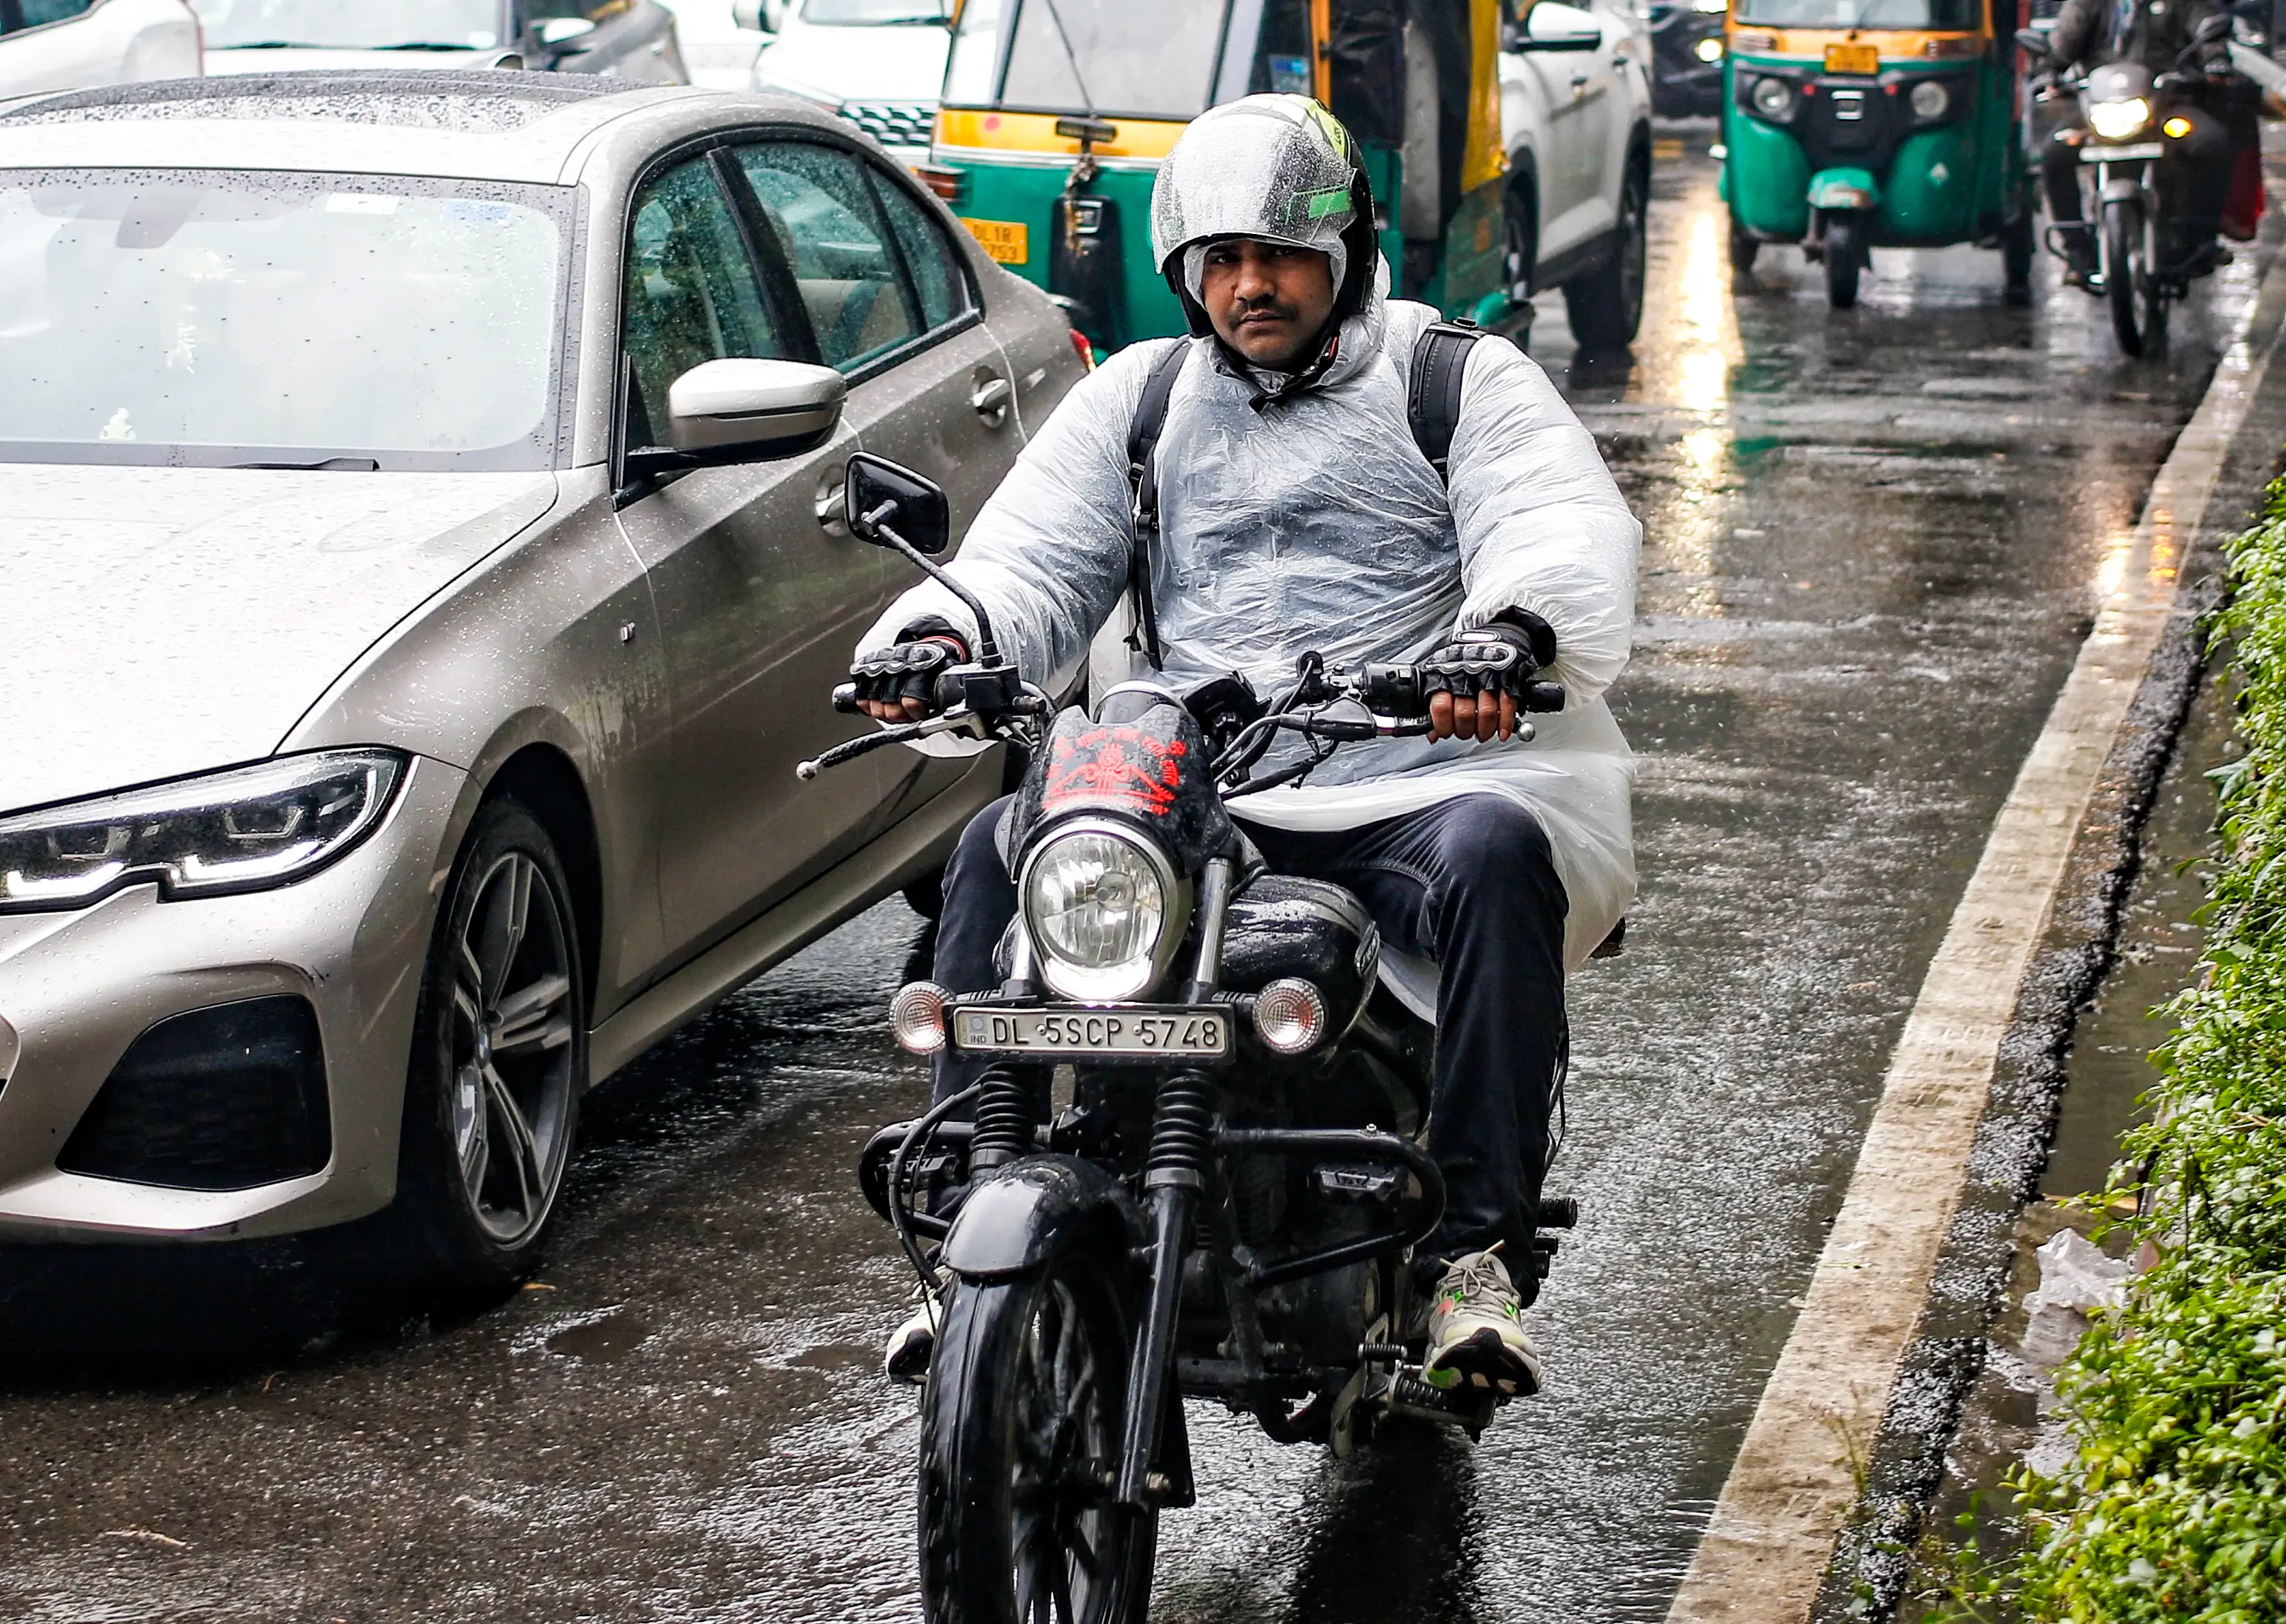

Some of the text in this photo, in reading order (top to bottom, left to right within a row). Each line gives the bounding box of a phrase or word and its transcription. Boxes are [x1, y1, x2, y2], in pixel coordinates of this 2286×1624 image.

[970, 1035, 987, 1044] IND
[992, 1014, 1217, 1047] DL 5SCP 5748
